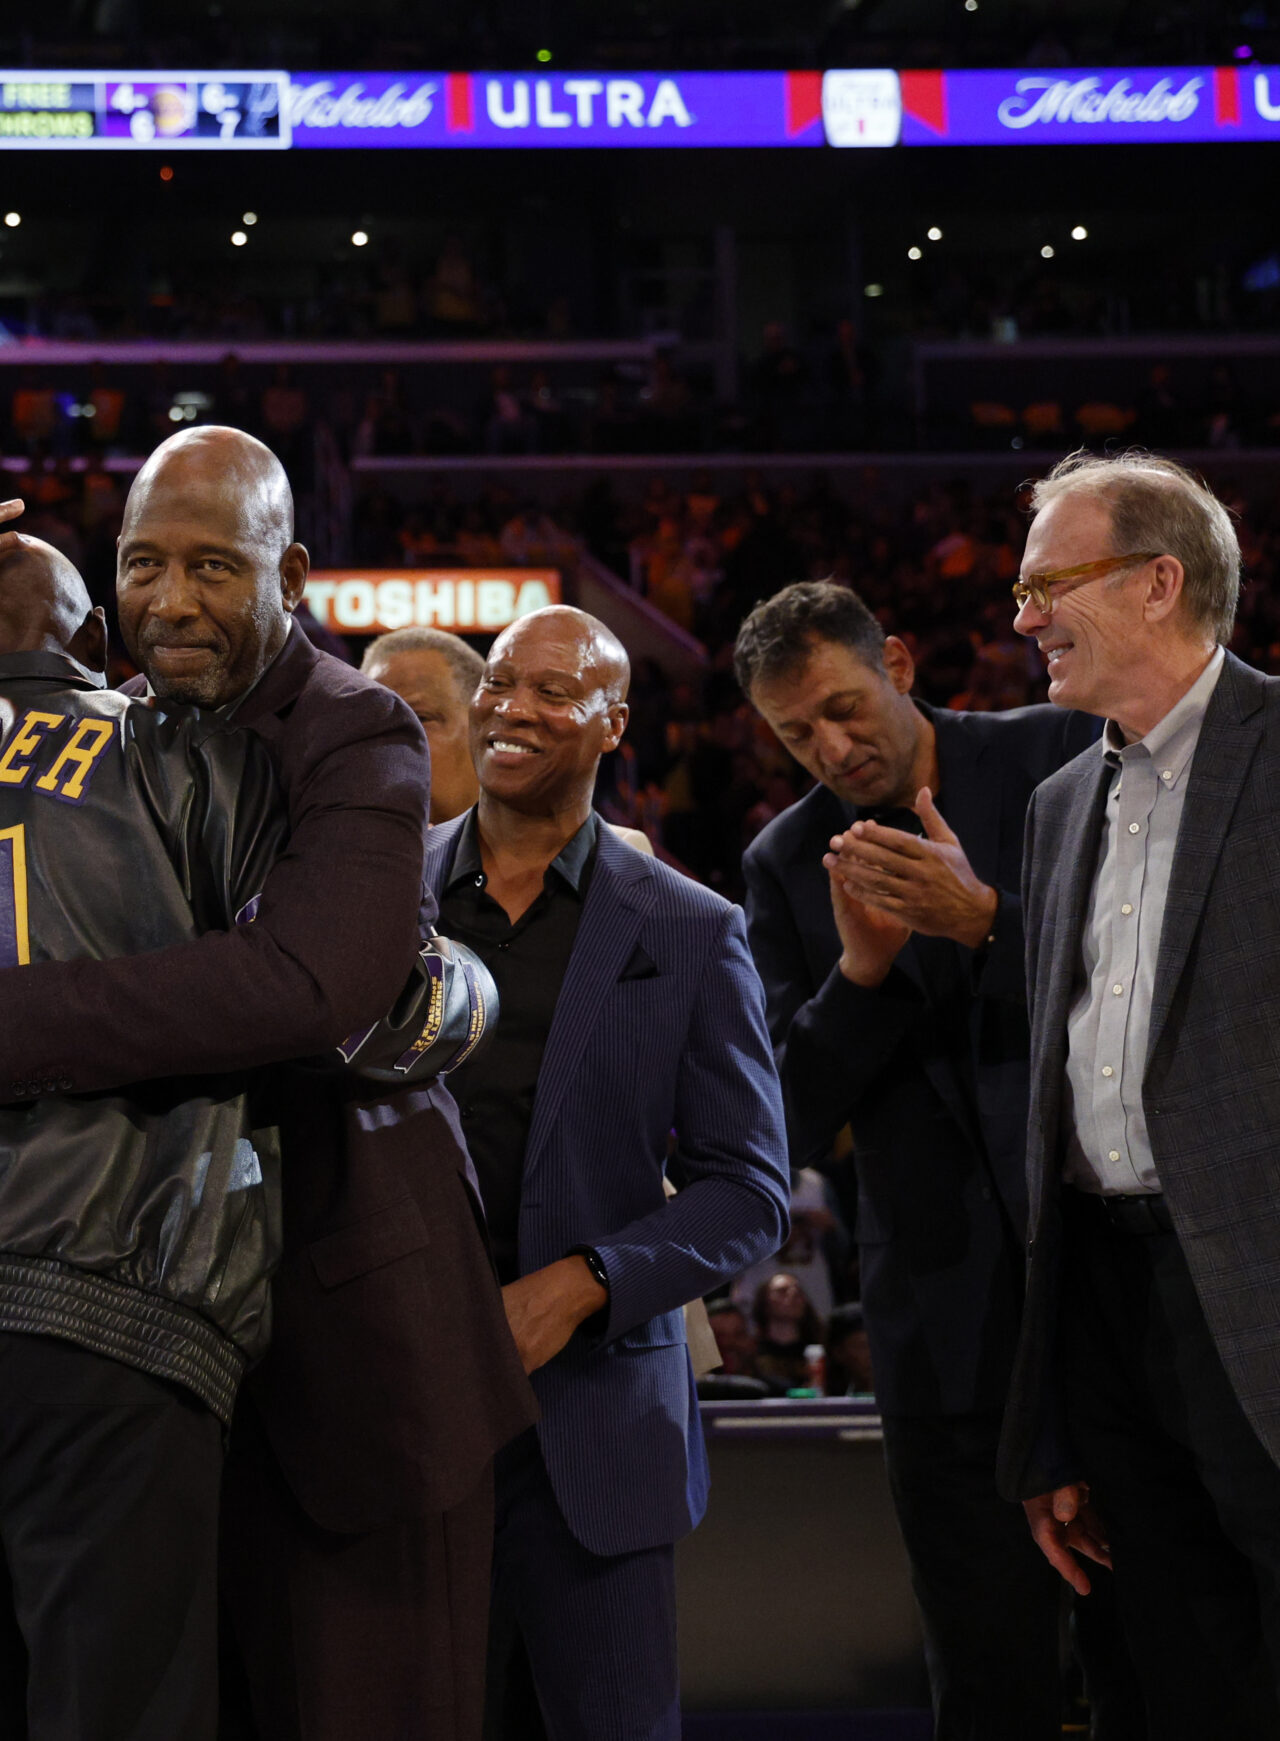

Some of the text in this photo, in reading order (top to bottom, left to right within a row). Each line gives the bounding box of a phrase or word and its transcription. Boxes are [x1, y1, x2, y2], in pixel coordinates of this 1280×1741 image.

[3, 82, 71, 108] FREE
[486, 79, 693, 129] ULTRA
[997, 76, 1206, 129] Michelob
[304, 579, 554, 630] TOSHIBA
[431, 980, 442, 1031] LAKERS
